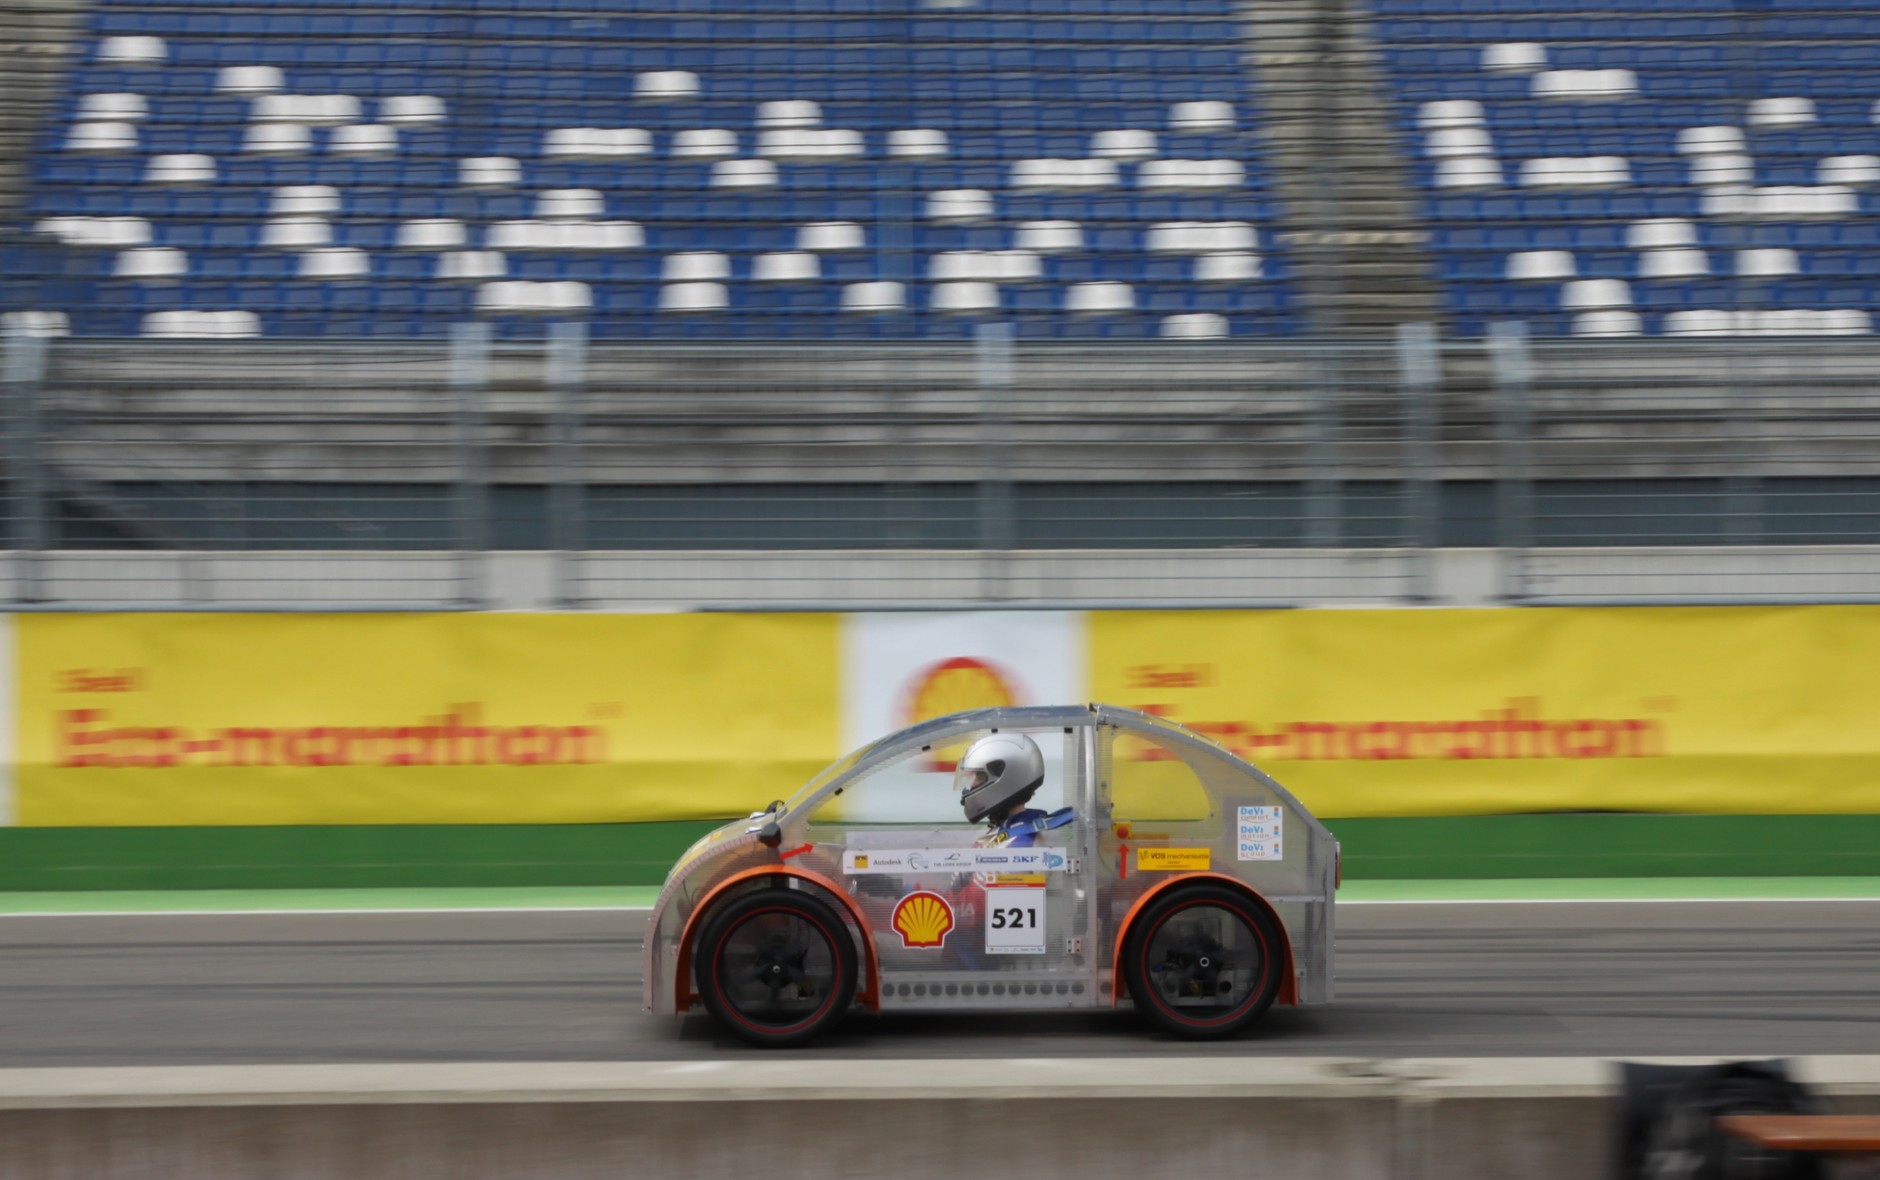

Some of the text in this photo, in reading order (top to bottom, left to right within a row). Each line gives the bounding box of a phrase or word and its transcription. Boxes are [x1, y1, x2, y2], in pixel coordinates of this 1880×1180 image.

[873, 858, 902, 866] Autodesk
[1012, 855, 1040, 863] SKF
[991, 907, 1036, 929] 521
